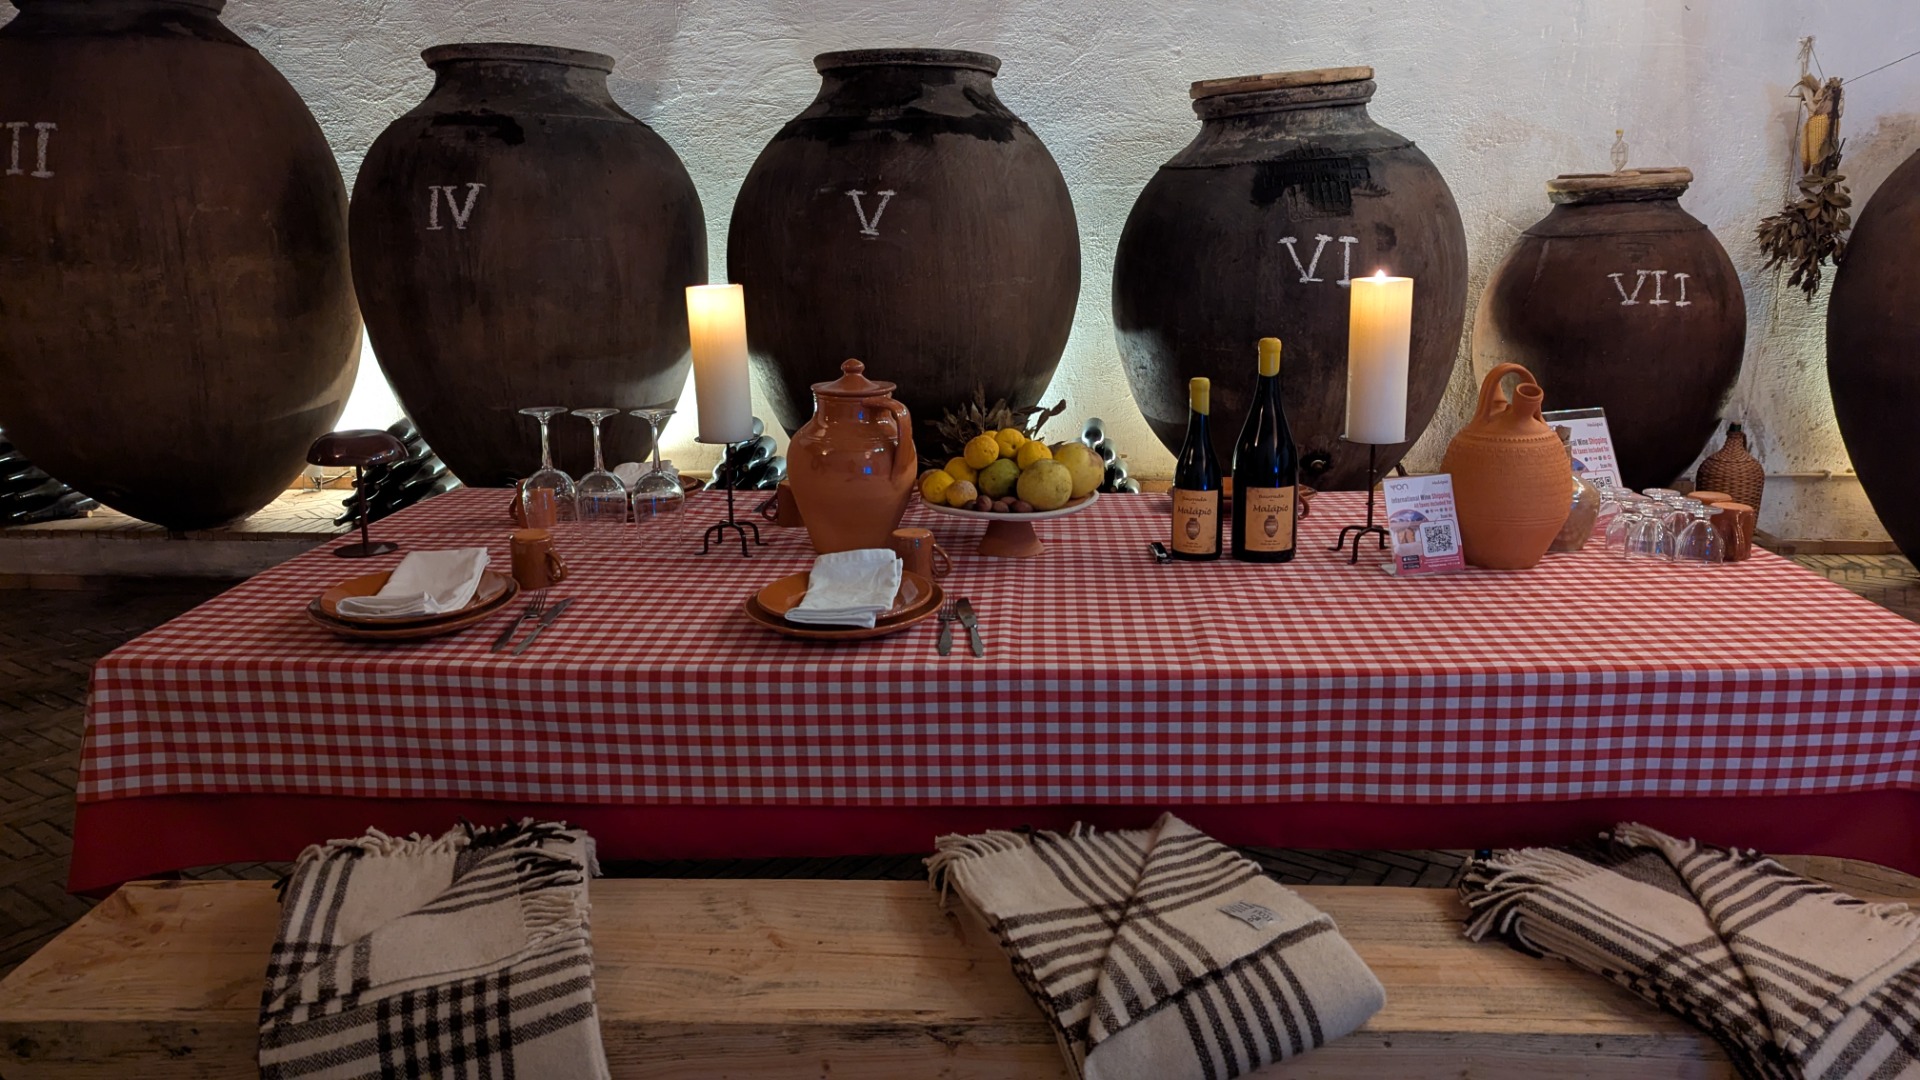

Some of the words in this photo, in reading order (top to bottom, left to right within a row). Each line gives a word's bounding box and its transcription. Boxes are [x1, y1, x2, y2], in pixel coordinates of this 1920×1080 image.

[426, 182, 486, 230] IV
[844, 188, 897, 236] V
[1277, 233, 1359, 286] VI
[1607, 269, 1692, 308] VII
[1588, 437, 1607, 445] Shipping
